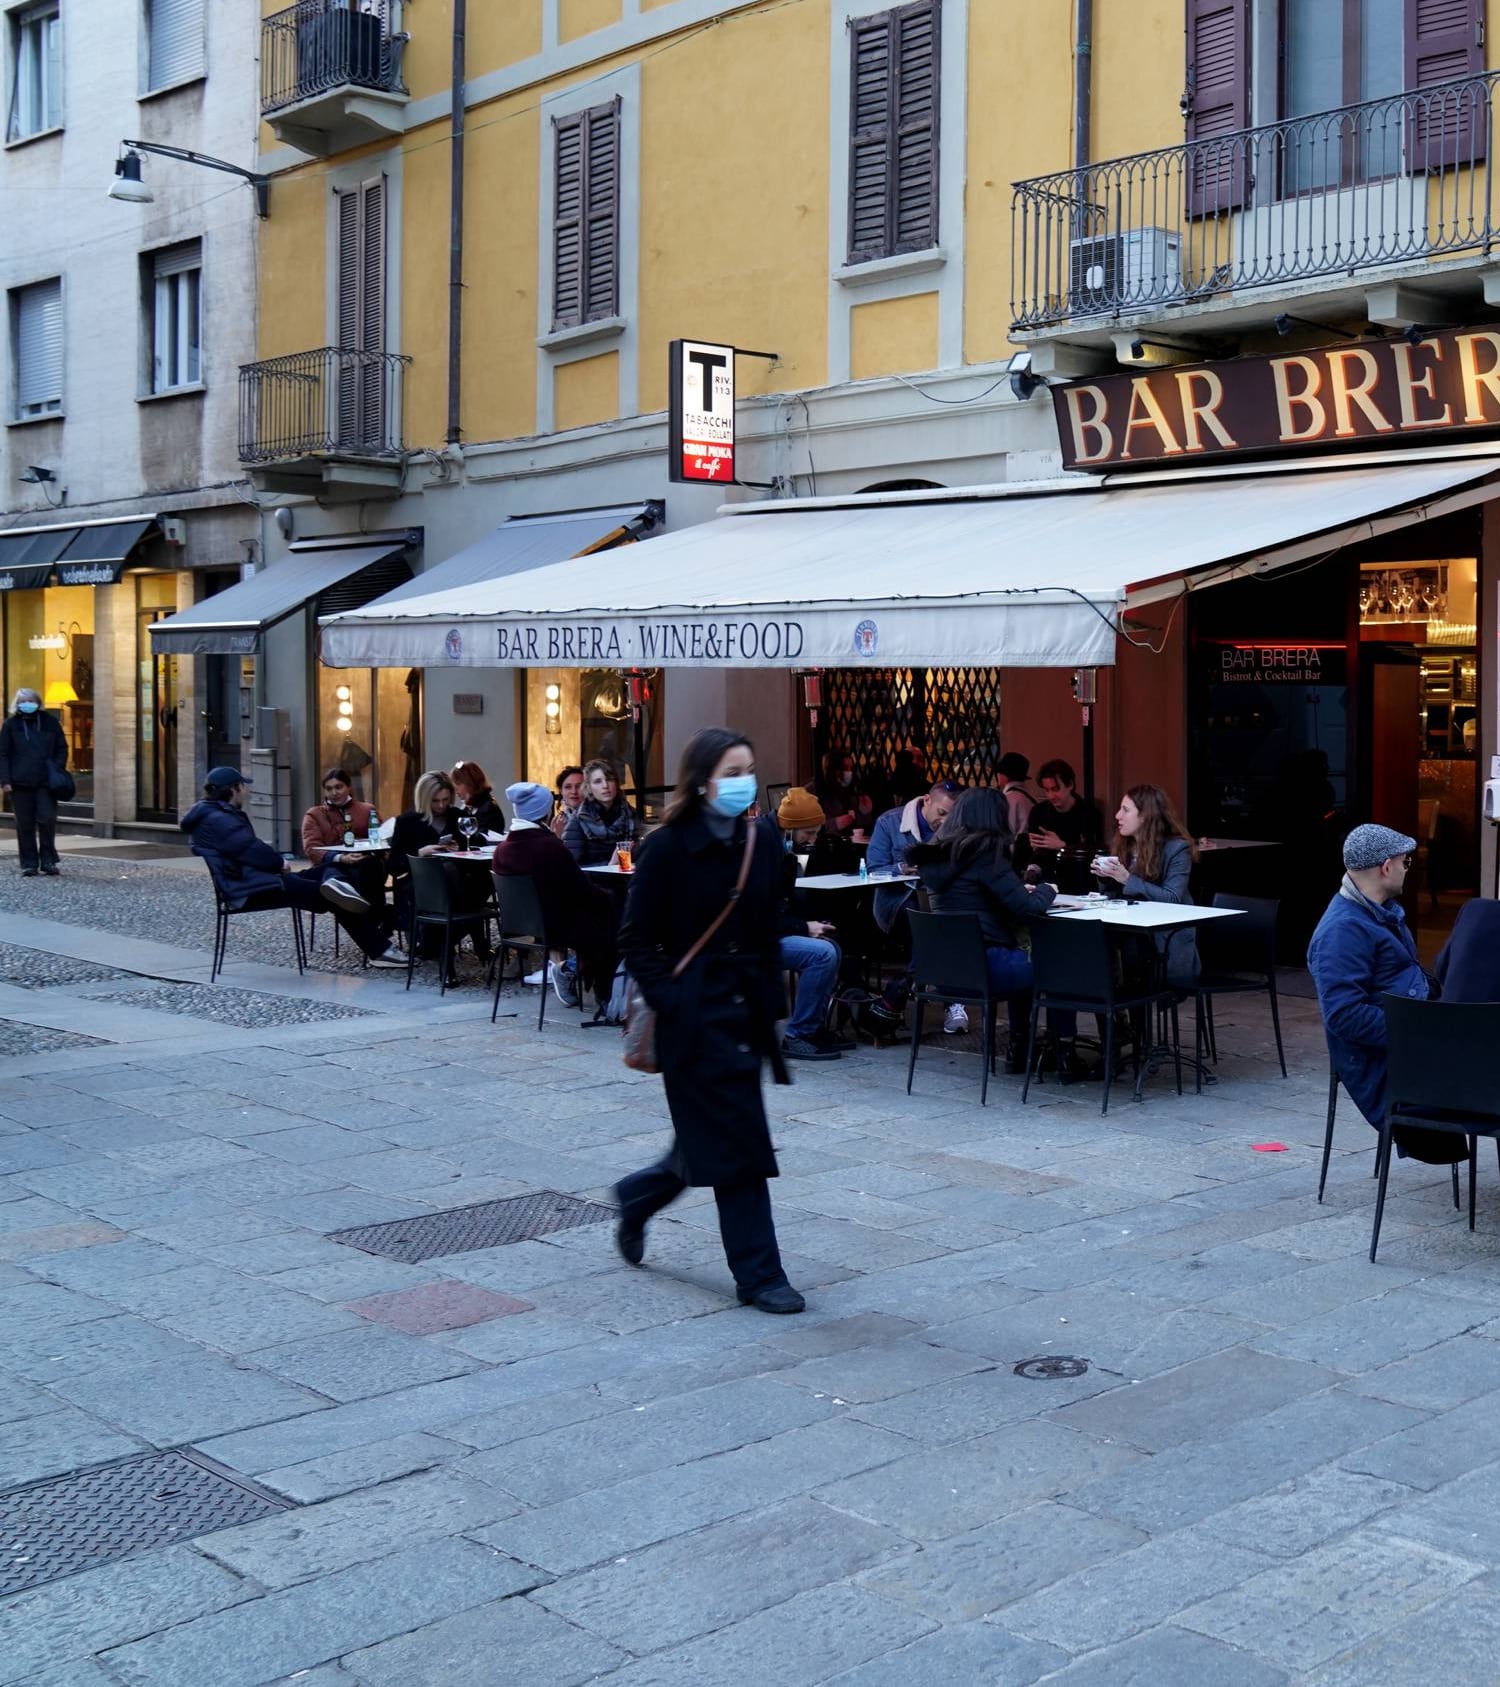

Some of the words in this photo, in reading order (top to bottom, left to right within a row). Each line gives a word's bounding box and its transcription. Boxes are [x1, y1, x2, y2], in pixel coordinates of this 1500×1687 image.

[689, 350, 726, 412] T
[715, 376, 732, 385] RIV.
[715, 386, 731, 395] 113
[685, 413, 731, 428] TABACCHI
[1064, 369, 1238, 464] BAR
[497, 627, 540, 660] BAR
[547, 625, 623, 660] BRERA
[638, 621, 804, 660] WINE&FOOD
[1222, 649, 1255, 669] BAR
[1261, 648, 1321, 667] BRERA
[1223, 671, 1252, 681] Bistrot
[1254, 671, 1262, 681] &
[1264, 669, 1302, 680] Cocktail
[1304, 669, 1321, 680] Bar
